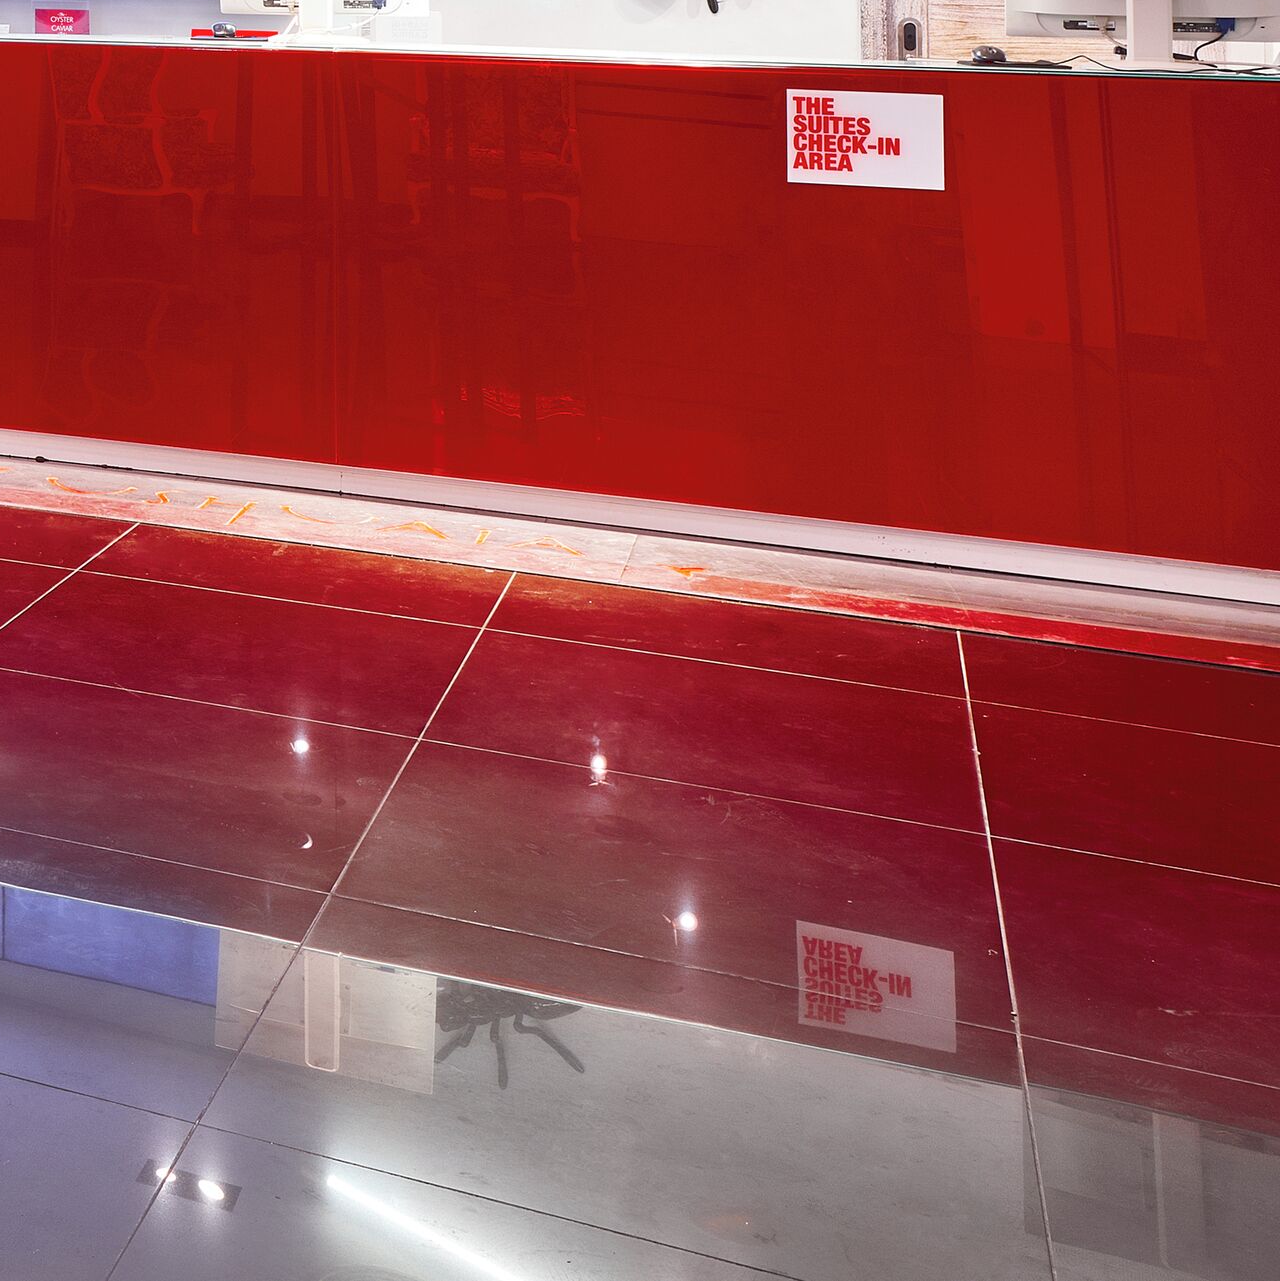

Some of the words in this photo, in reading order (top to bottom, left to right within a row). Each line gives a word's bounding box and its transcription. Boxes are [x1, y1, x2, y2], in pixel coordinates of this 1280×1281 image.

[792, 96, 835, 115] THE
[793, 115, 871, 136] SUITES
[793, 133, 901, 156] CHECK-IN
[793, 152, 853, 171] AREA
